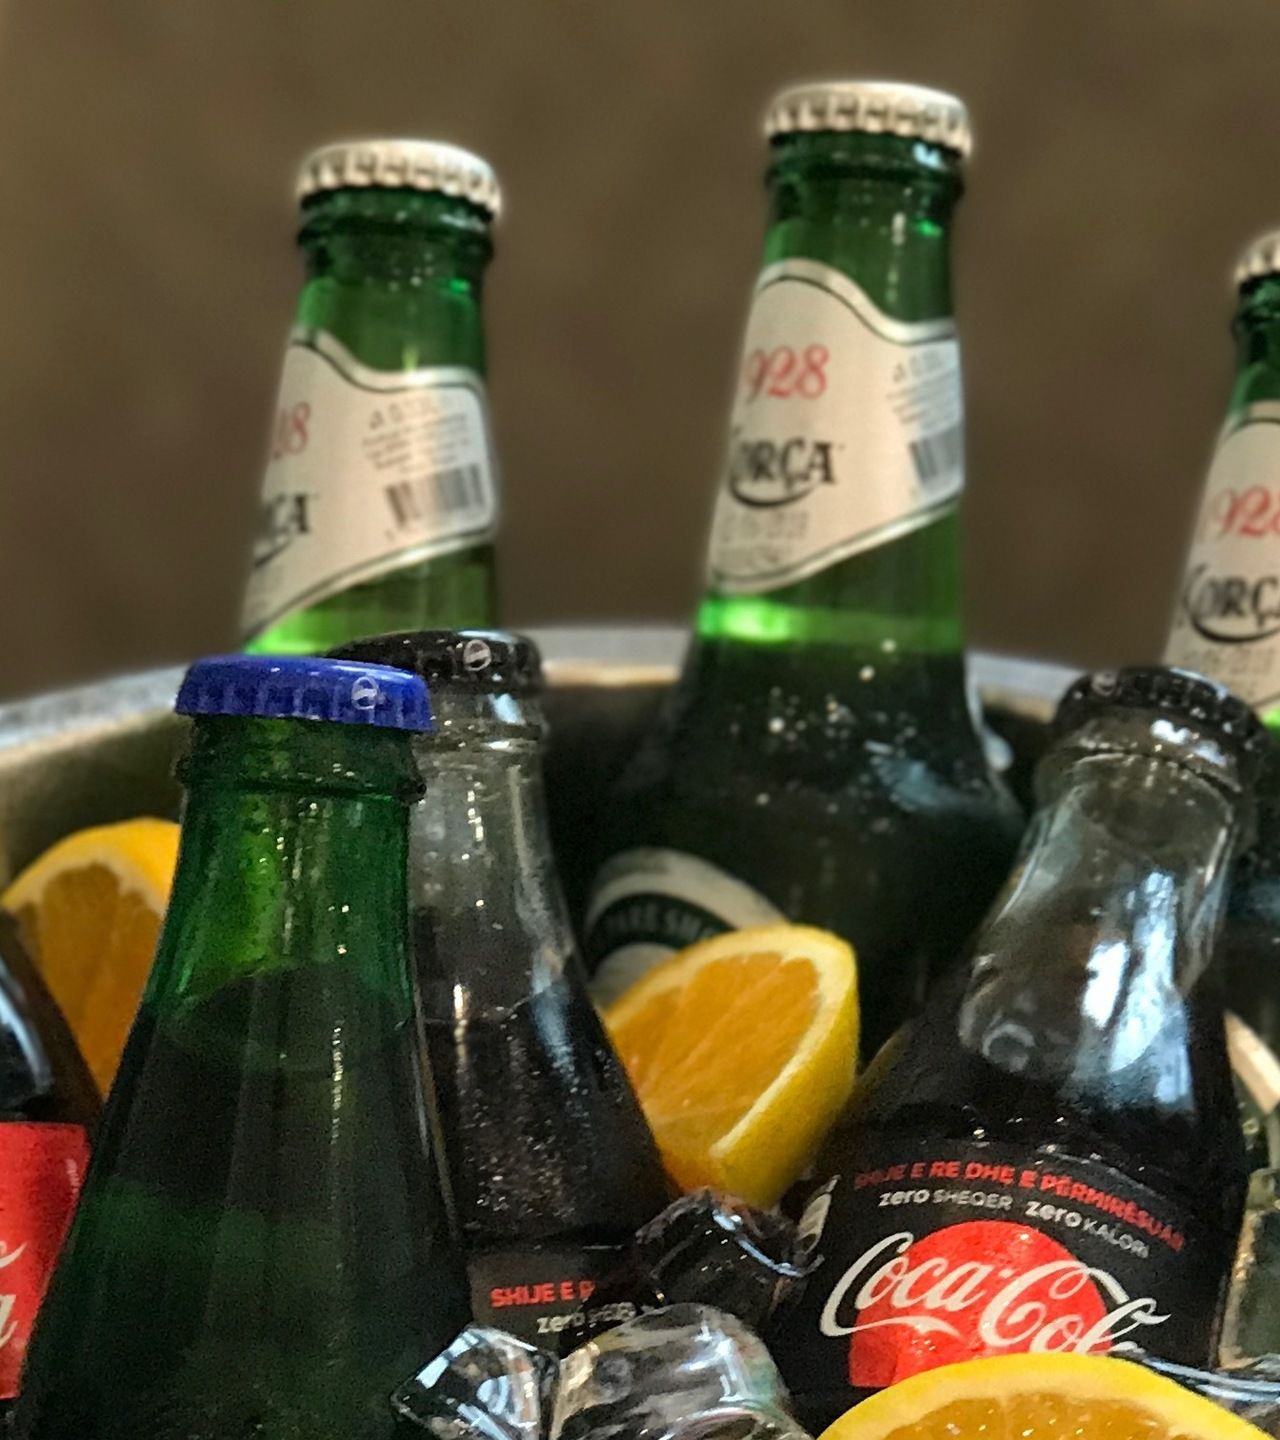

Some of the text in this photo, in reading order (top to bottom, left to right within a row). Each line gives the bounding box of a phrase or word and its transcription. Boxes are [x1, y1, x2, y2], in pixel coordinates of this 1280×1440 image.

[743, 345, 831, 403] 928
[909, 1162, 926, 1179] E
[928, 1161, 961, 1178] RE
[963, 1162, 1016, 1185] DHE
[1019, 1170, 1037, 1188] E
[877, 1188, 1150, 1260] zero SHEQER zero KALORI
[559, 1279, 574, 1301] E
